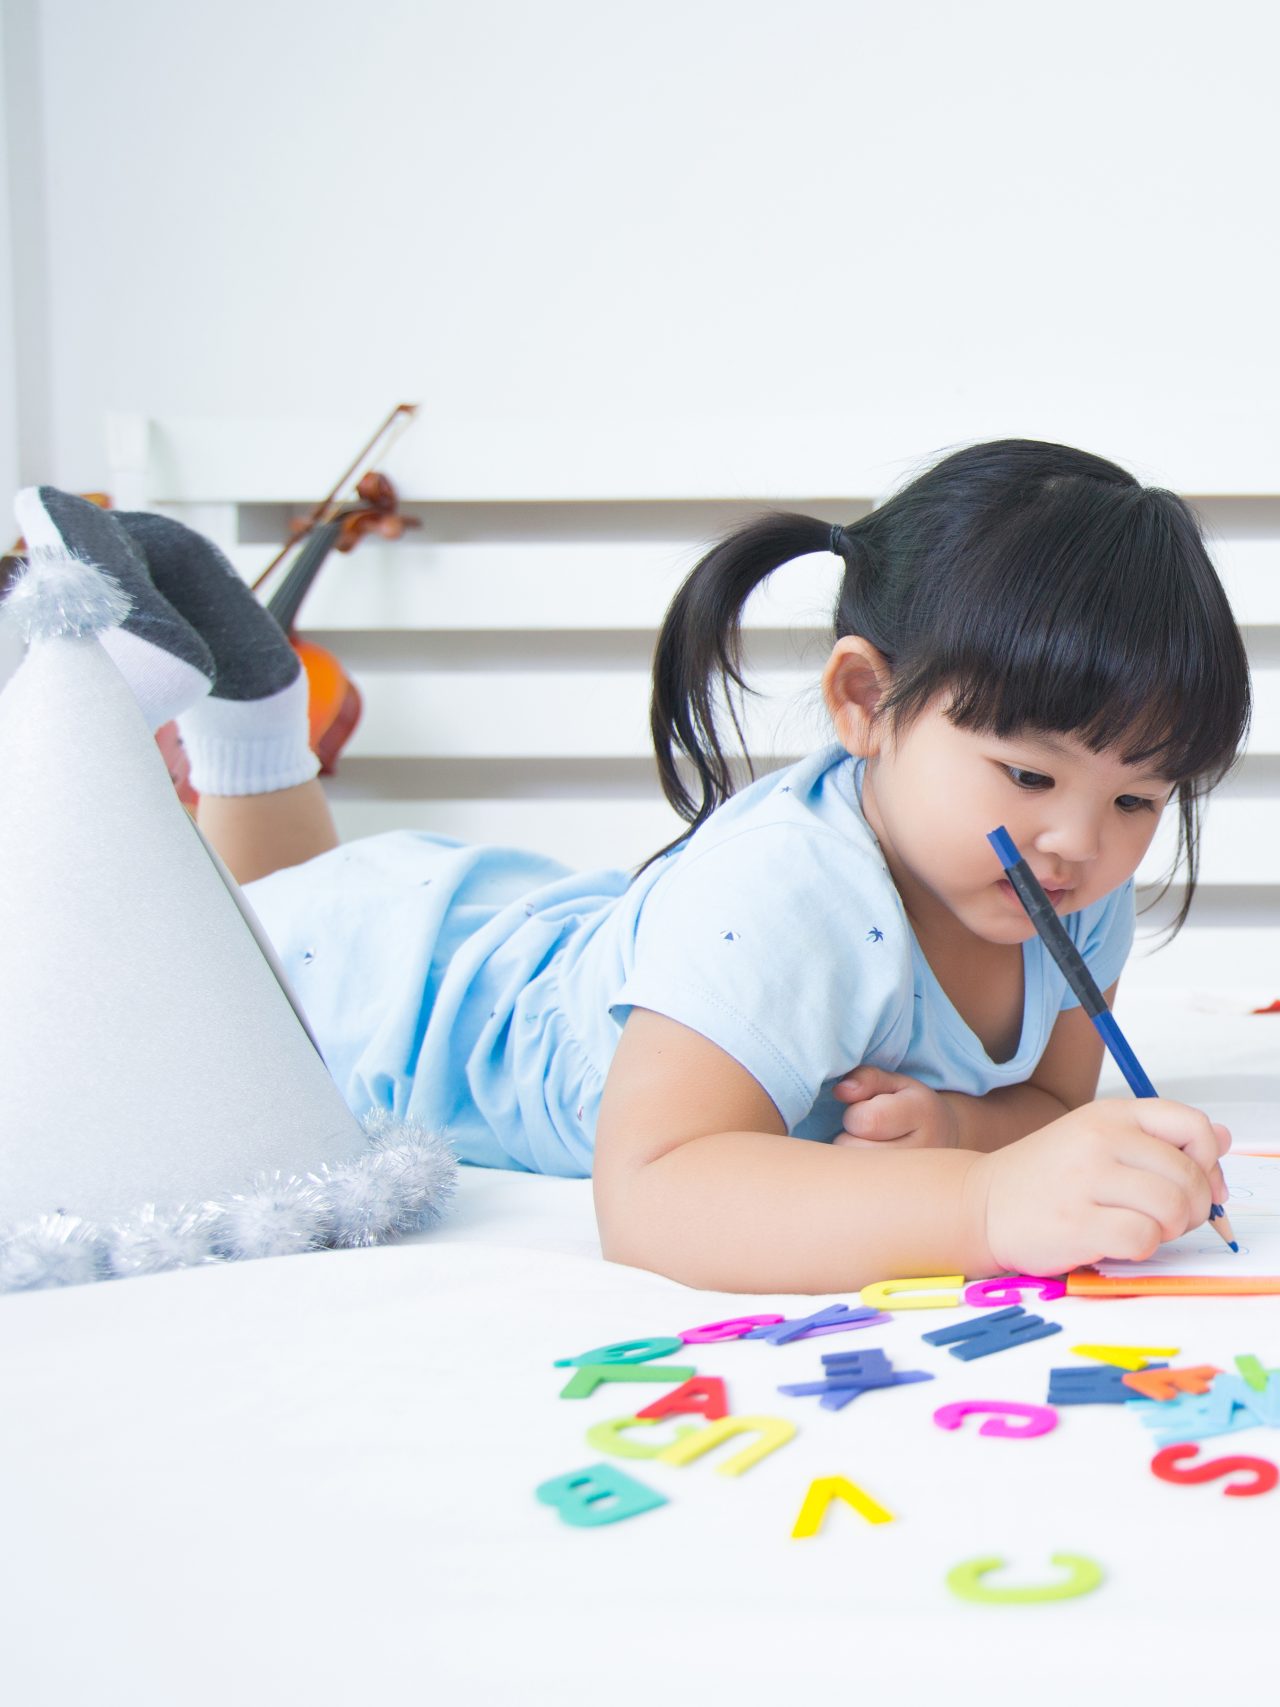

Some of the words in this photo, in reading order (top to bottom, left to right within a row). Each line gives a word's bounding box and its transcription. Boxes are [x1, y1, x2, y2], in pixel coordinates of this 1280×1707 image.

[634, 1376, 729, 1422] A
[534, 1461, 671, 1529] B
[1150, 1442, 1280, 1498] S
[790, 1473, 896, 1539] V
[943, 1550, 1106, 1607] C
